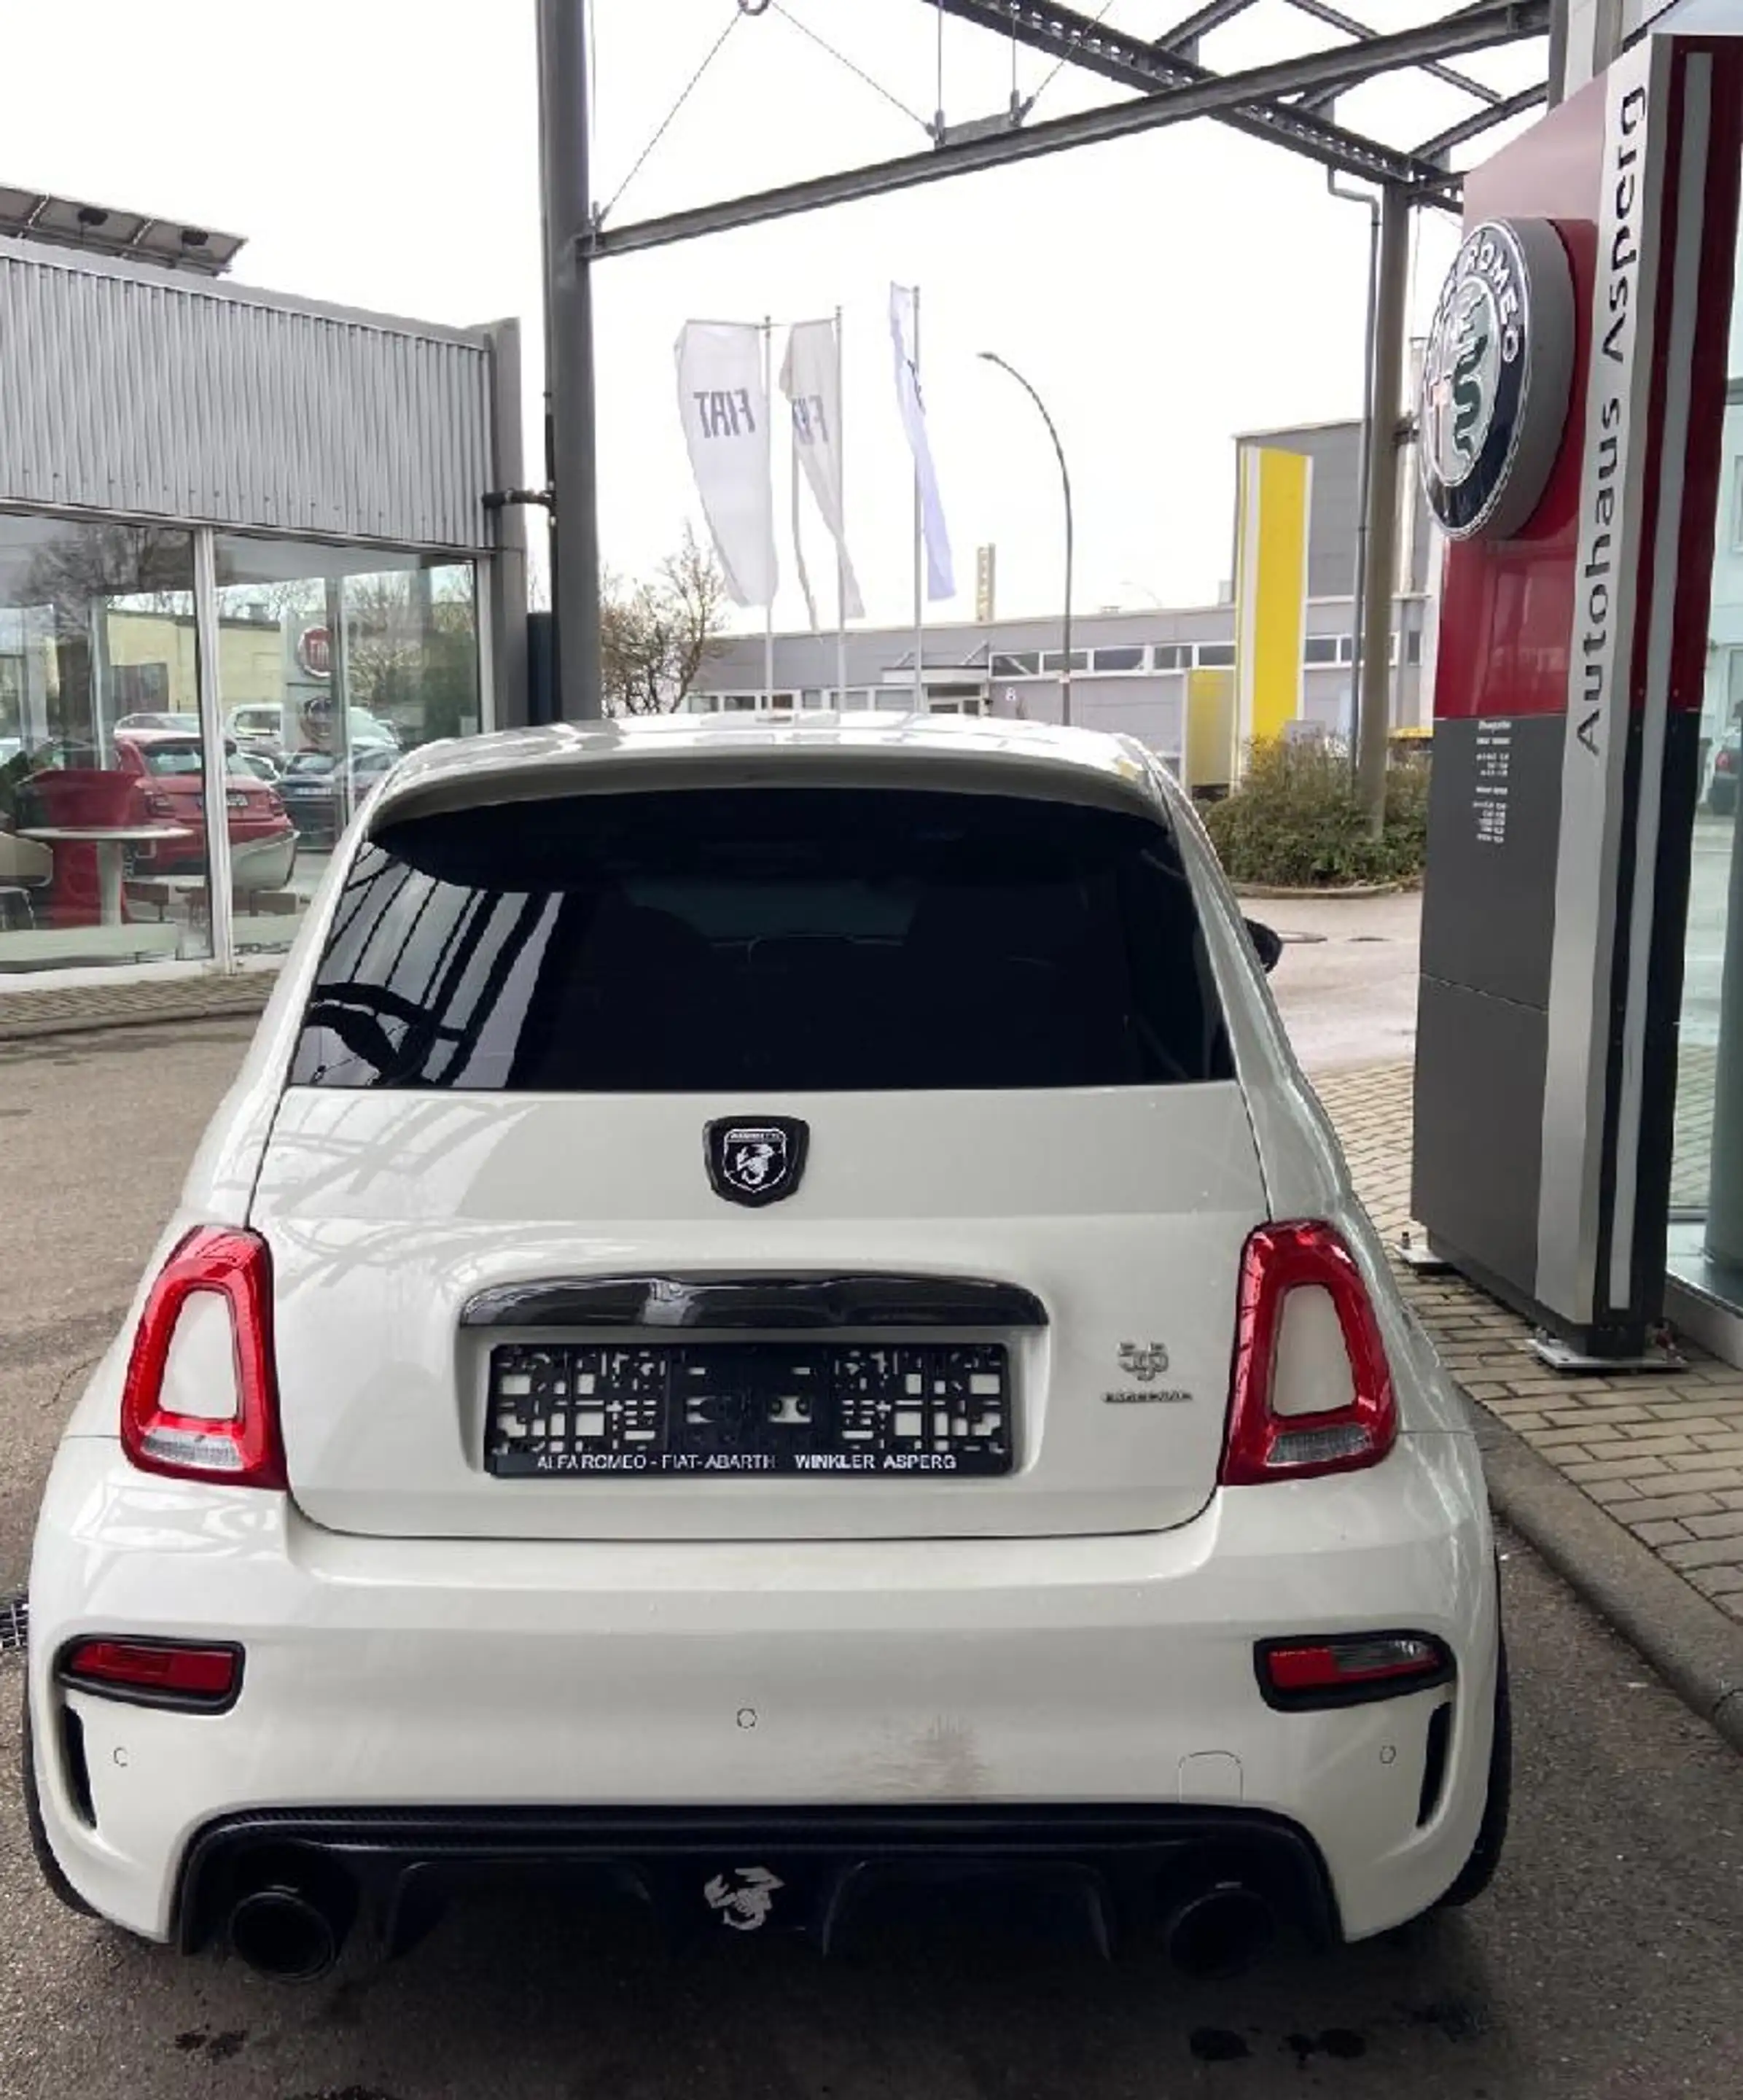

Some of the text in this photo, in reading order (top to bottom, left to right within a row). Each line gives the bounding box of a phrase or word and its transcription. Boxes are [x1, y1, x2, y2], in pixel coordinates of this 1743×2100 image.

[1576, 85, 1646, 757] Autohaus Asperg
[537, 1454, 578, 1470] ALFA
[581, 1454, 647, 1470] ROMEO
[795, 1454, 876, 1470] WINKLER
[882, 1454, 957, 1470] ASPERG
